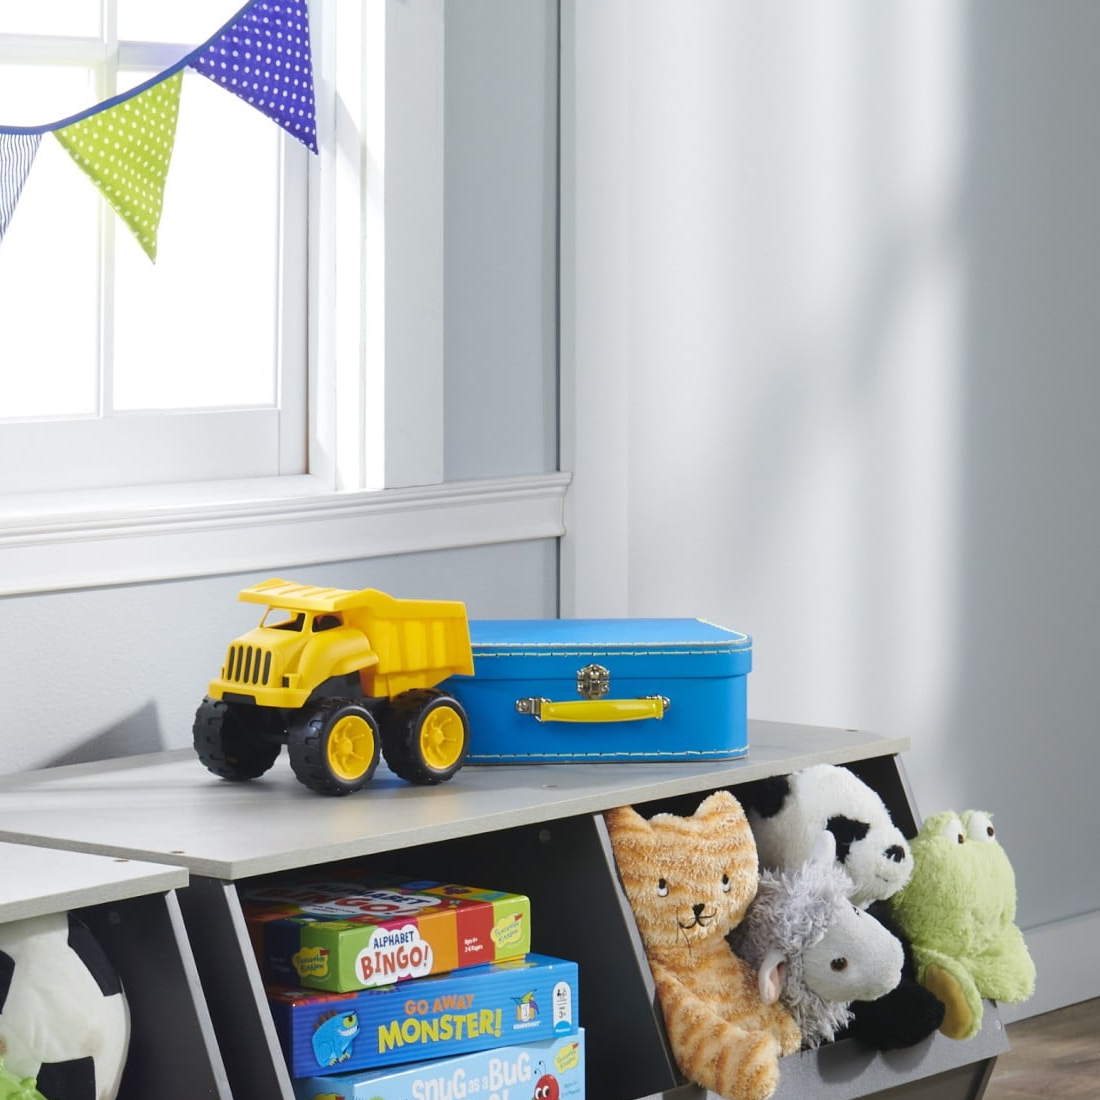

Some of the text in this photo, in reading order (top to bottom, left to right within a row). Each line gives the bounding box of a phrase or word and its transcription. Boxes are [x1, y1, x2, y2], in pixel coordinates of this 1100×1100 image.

[373, 931, 415, 949] ALPHABET
[360, 945, 429, 981] BINGO!
[405, 995, 475, 1015] GO AWAY
[378, 1008, 502, 1054] MONSTER!
[468, 1077, 480, 1093] as
[482, 1076, 488, 1090] a
